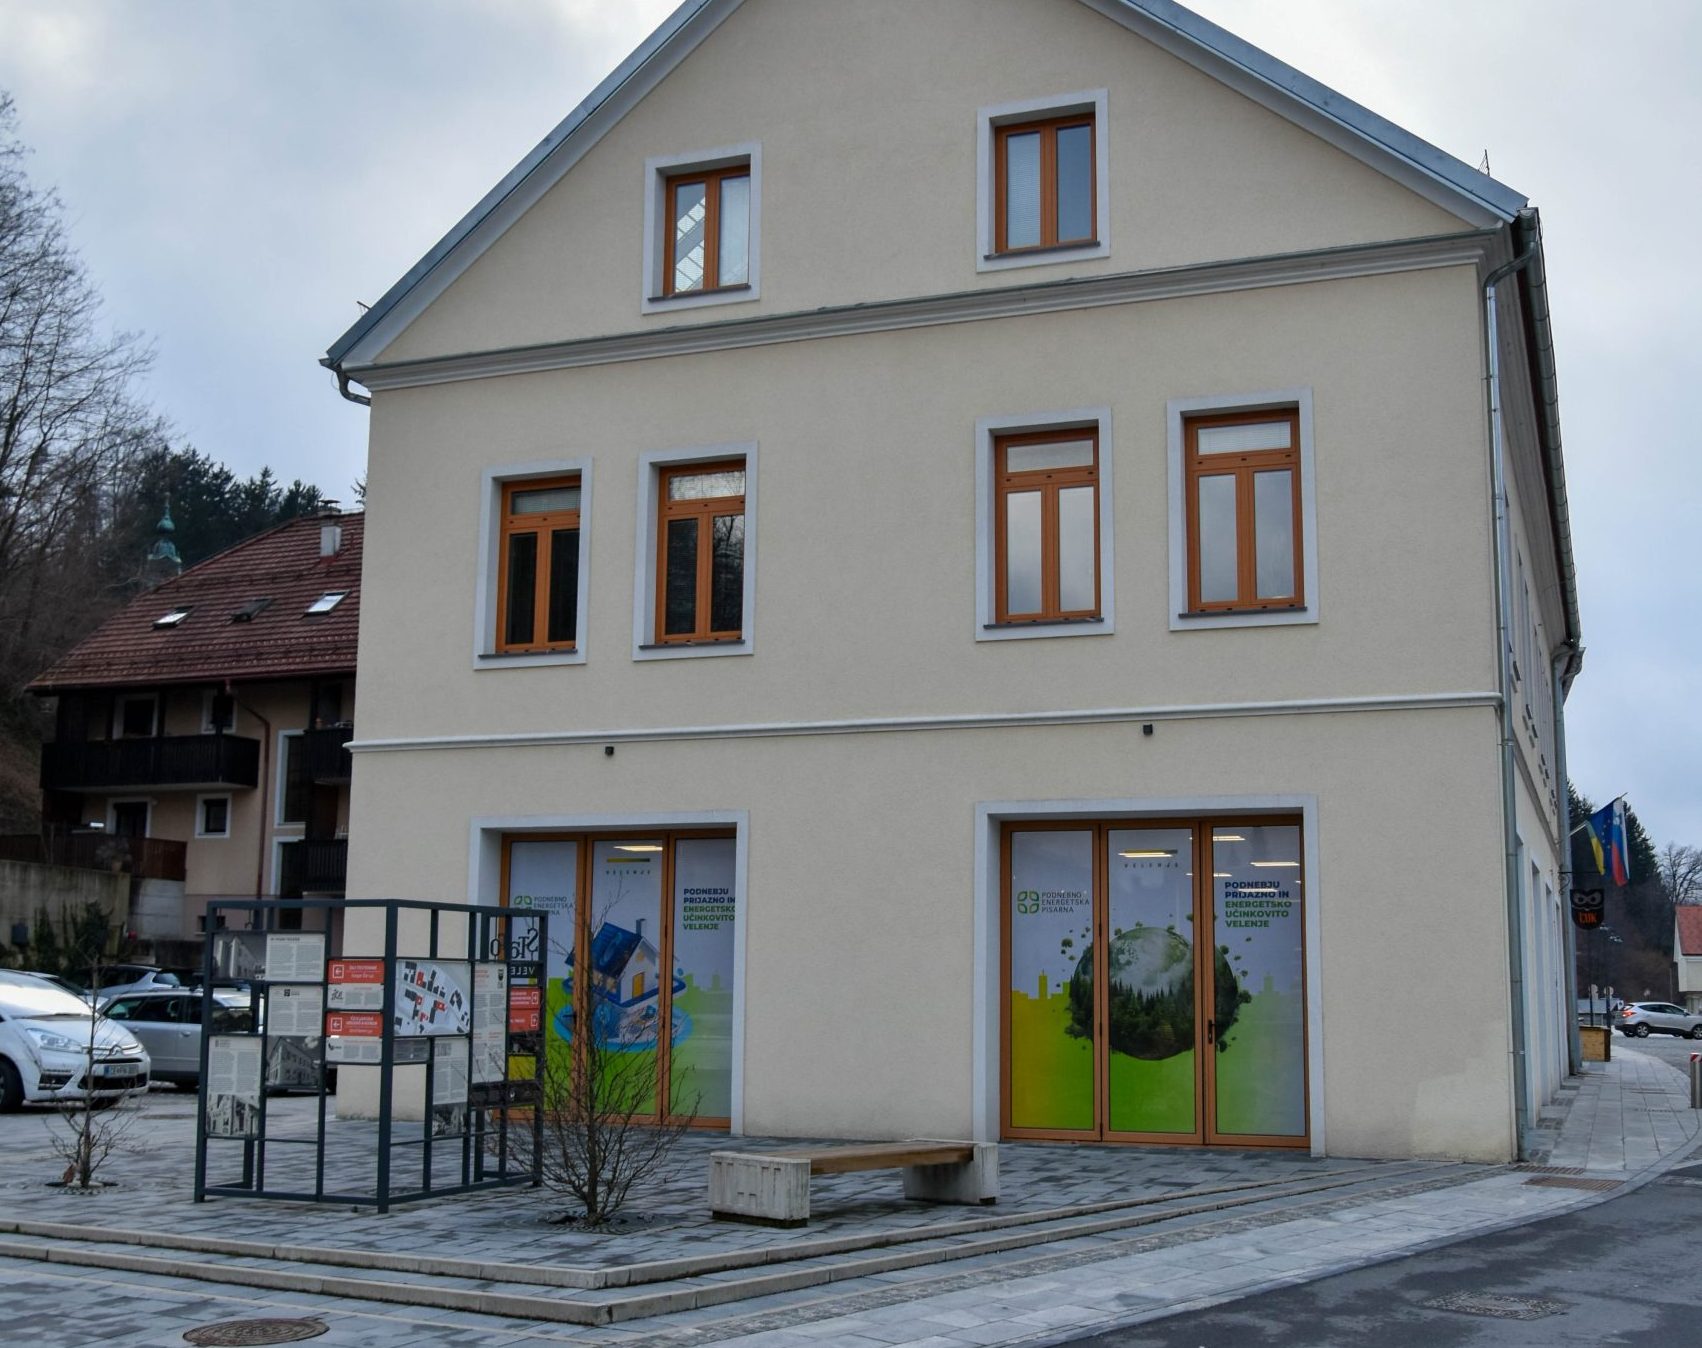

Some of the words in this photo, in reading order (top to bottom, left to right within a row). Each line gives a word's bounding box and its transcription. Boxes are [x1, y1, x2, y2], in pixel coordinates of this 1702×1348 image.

[1225, 881, 1280, 889] PODNEBJU
[1278, 890, 1289, 898] IN
[1225, 909, 1289, 918] UČINKOVITO
